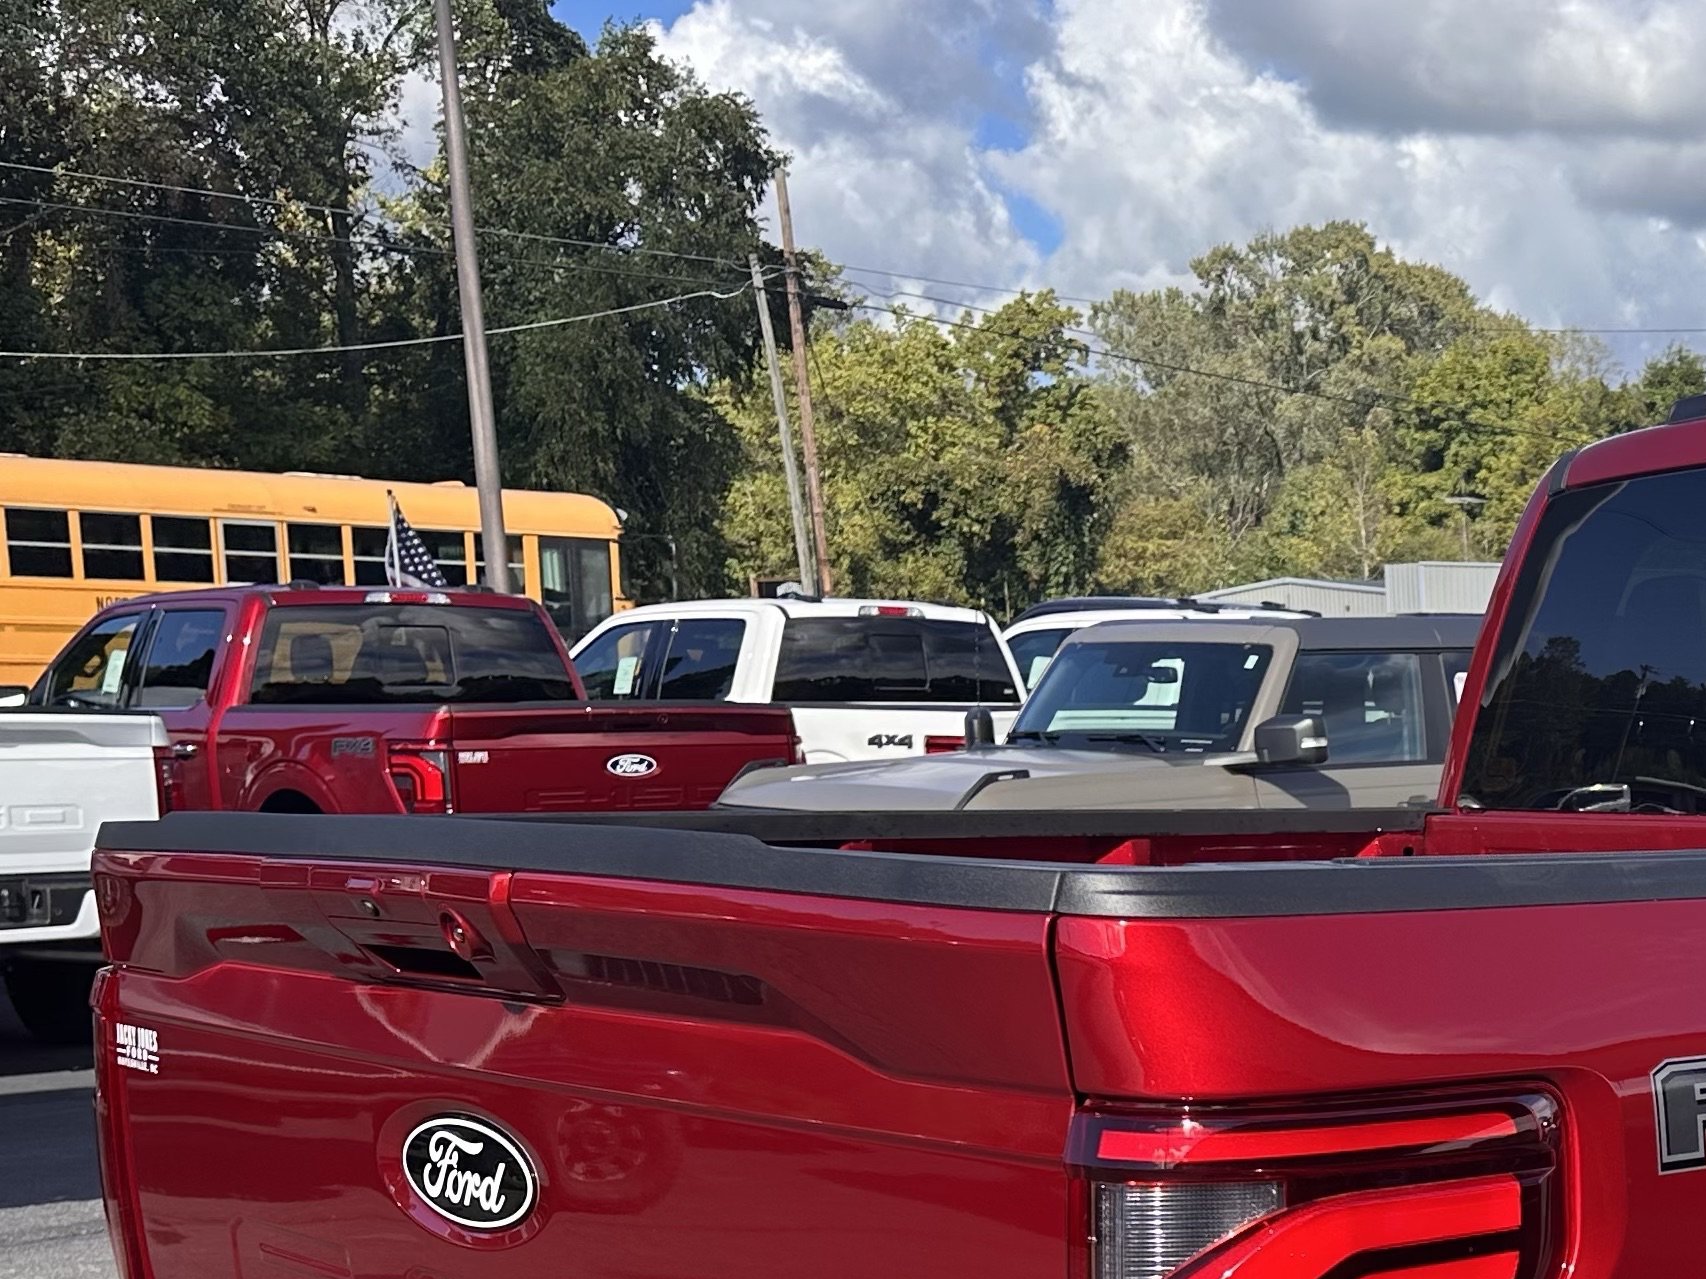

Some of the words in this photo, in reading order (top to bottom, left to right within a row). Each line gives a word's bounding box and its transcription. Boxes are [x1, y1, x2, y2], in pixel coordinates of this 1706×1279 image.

[116, 1022, 136, 1047] JACKY
[126, 1045, 148, 1061] FORD
[423, 1130, 506, 1214] Ford
